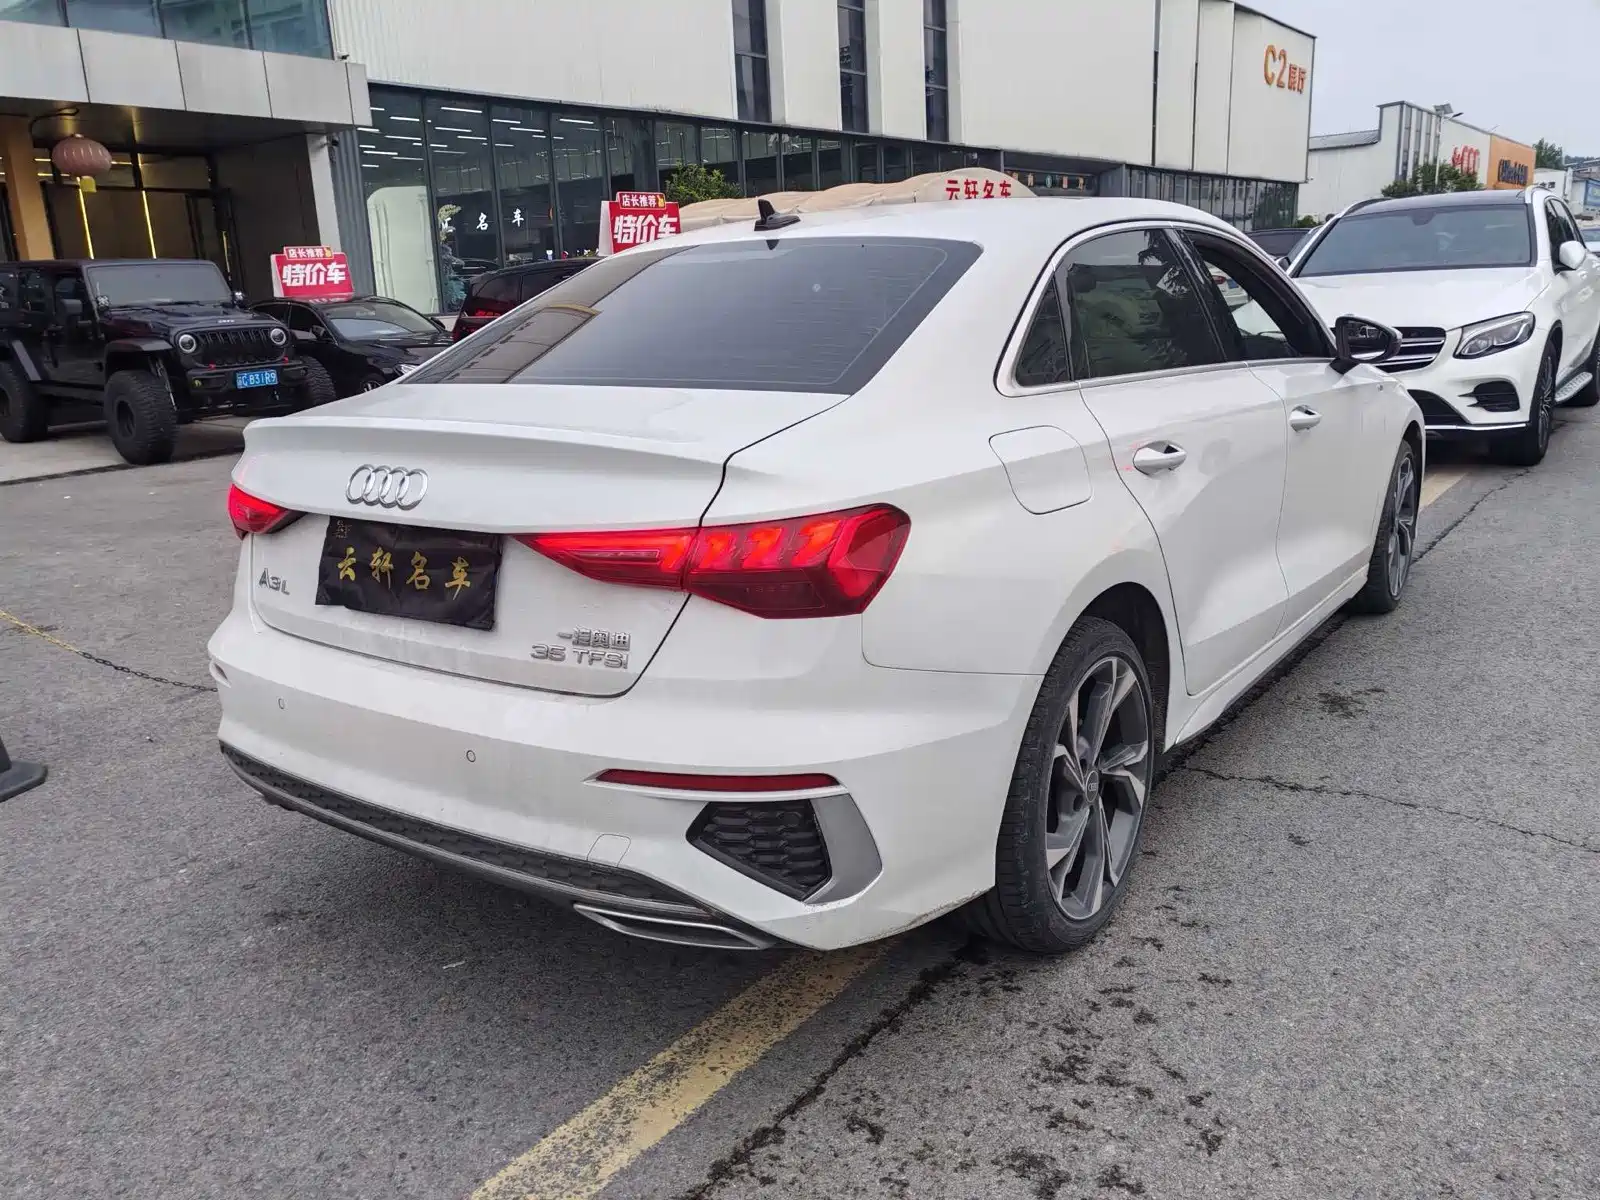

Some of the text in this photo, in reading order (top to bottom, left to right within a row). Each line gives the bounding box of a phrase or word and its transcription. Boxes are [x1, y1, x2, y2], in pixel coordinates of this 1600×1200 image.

[622, 194, 657, 208] 店长推荐
[613, 213, 678, 244] 特价车
[288, 247, 325, 259] 店长推荐
[282, 261, 347, 287] 特价车
[258, 567, 290, 596] A3L
[530, 644, 566, 662] 35
